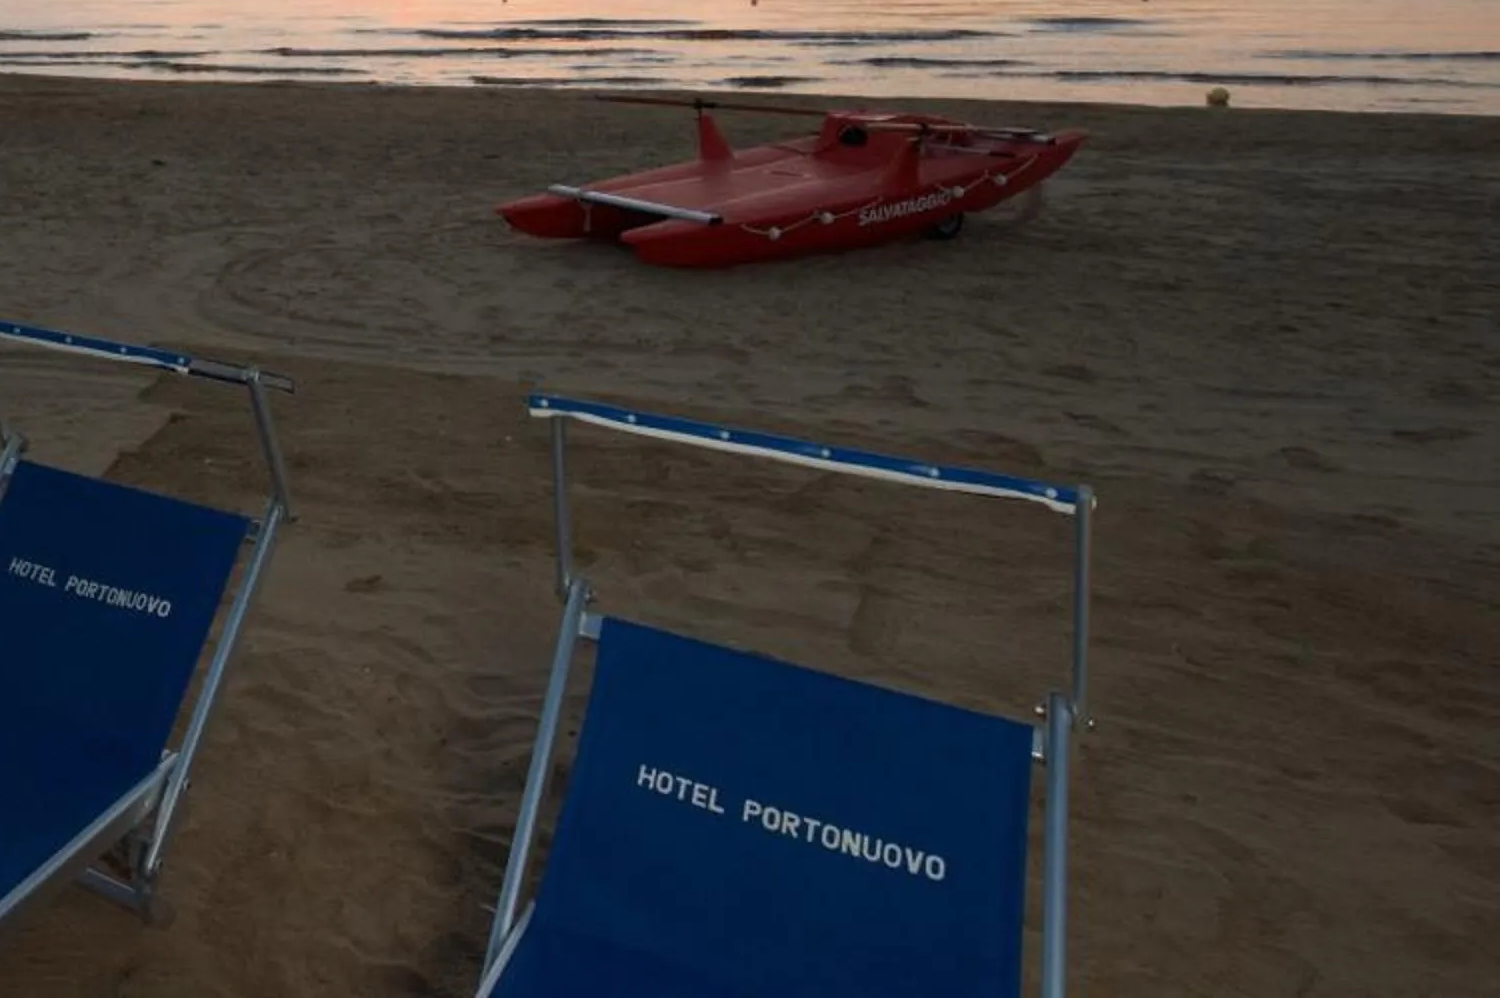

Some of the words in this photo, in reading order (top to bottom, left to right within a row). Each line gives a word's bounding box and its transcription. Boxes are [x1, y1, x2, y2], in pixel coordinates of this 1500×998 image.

[8, 557, 56, 587] HOTEL
[64, 575, 172, 618] PORTONUOVO
[636, 764, 725, 815] HOTEL
[742, 798, 946, 882] PORTONUOVO
